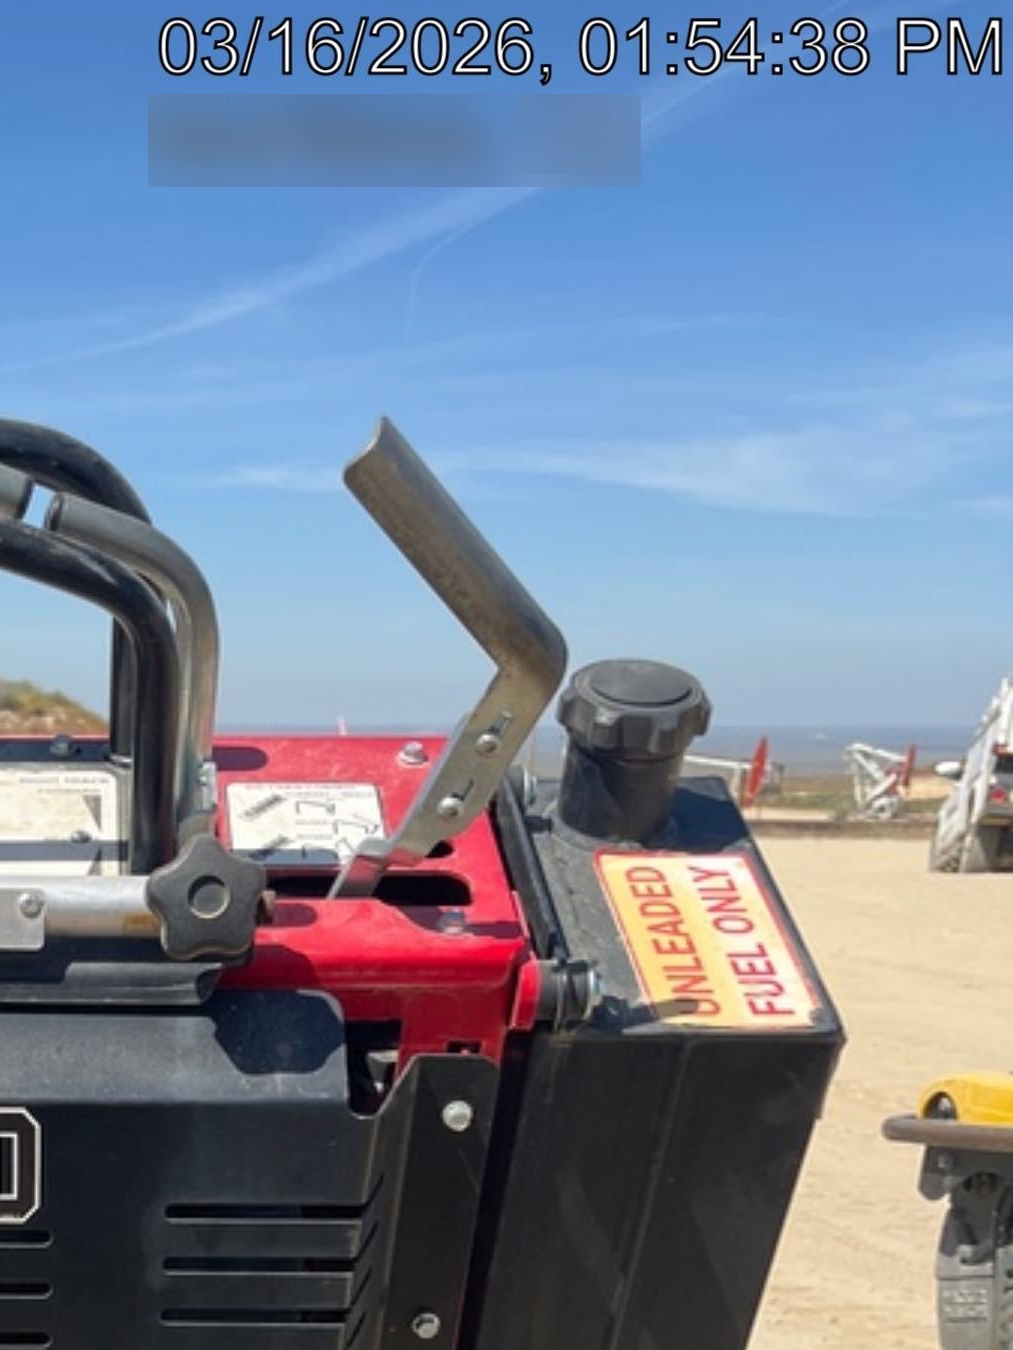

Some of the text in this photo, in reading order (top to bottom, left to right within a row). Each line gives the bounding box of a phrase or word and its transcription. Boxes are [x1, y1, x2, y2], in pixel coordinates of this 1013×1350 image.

[624, 866, 721, 1018] UNLEADED
[687, 865, 795, 1017] FUEL ONLY
